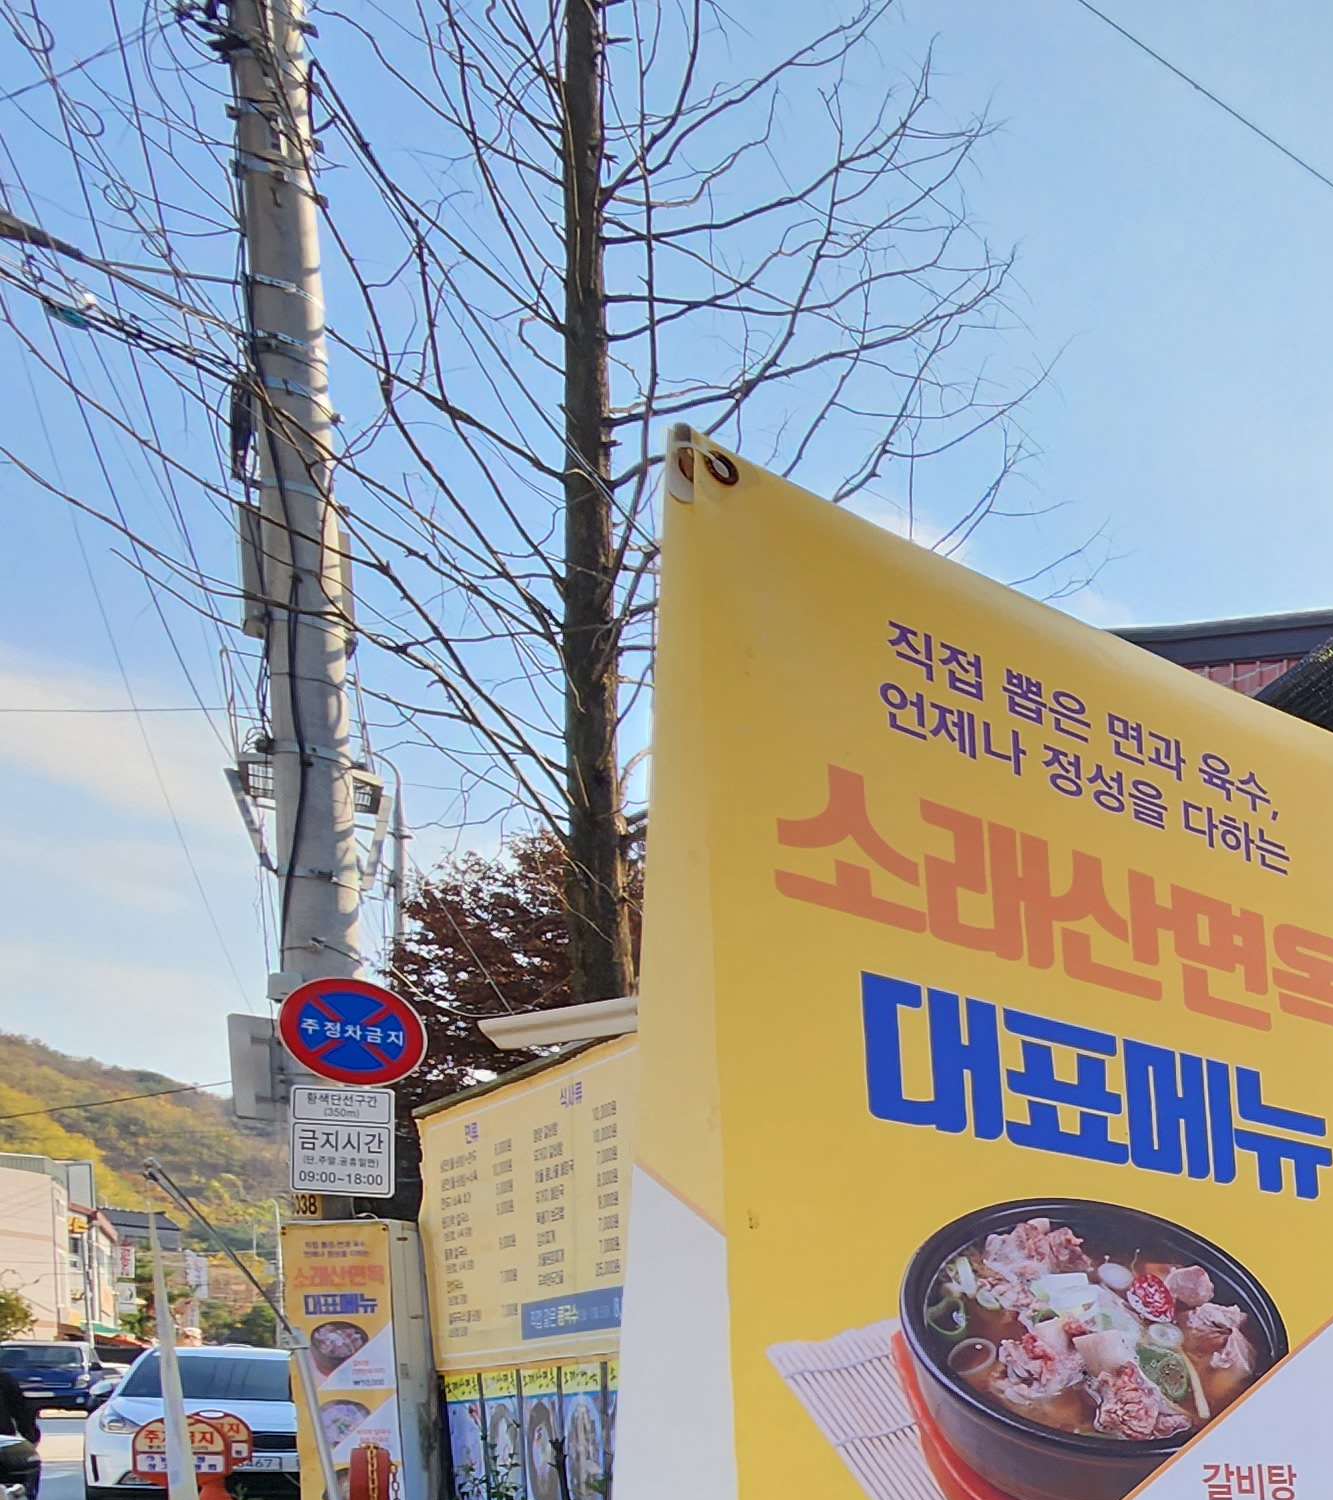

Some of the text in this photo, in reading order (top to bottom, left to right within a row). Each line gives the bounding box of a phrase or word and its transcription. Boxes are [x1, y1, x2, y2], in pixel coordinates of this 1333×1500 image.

[887, 619, 1279, 821] 직접 뽑은 면과 육수,
[879, 682, 1290, 875] 언제나 정성을 다하는
[301, 1017, 405, 1047] 주정차금지
[860, 969, 1333, 1200] 대표메뉴
[298, 1129, 384, 1155] 금지시간
[323, 1107, 360, 1119] (350m)
